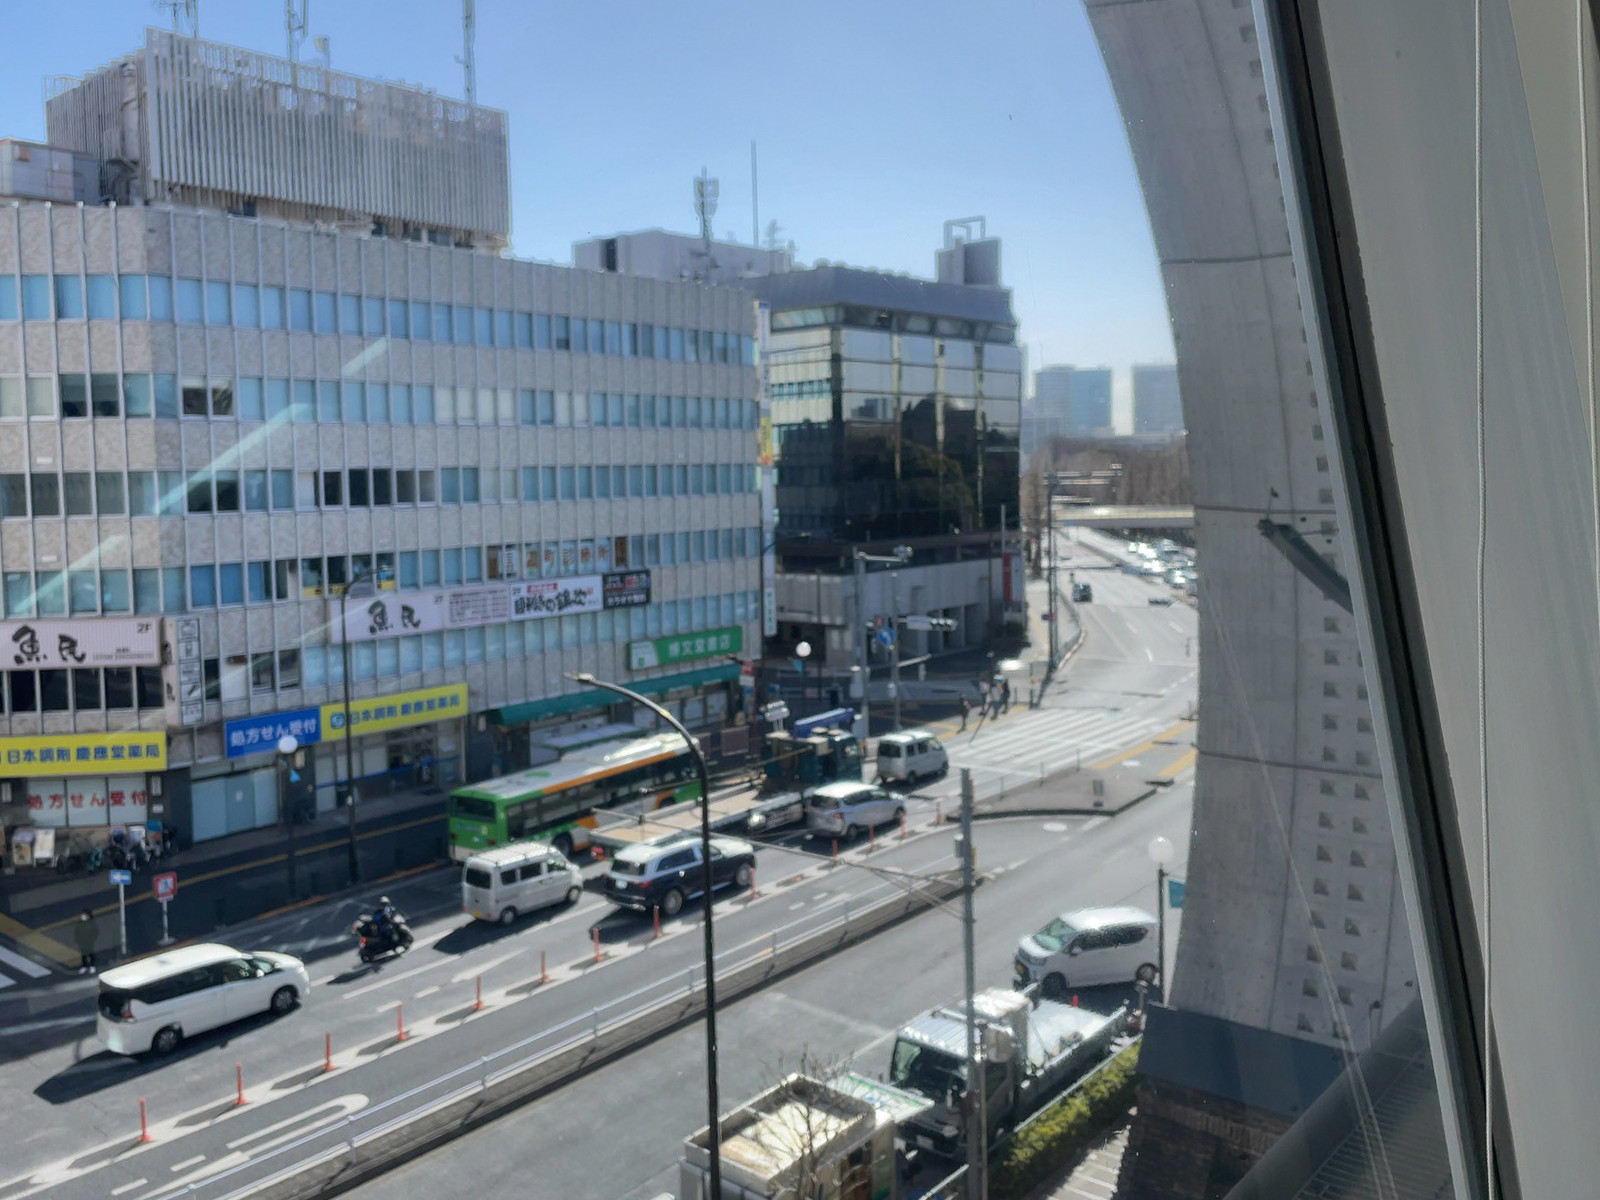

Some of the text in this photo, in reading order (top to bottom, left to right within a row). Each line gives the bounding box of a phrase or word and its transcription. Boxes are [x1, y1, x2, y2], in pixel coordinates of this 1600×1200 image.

[137, 623, 151, 634] 2F
[12, 624, 86, 664] 魚民
[230, 718, 317, 747] 処方せん受付
[27, 790, 147, 810] 処方せん受付
